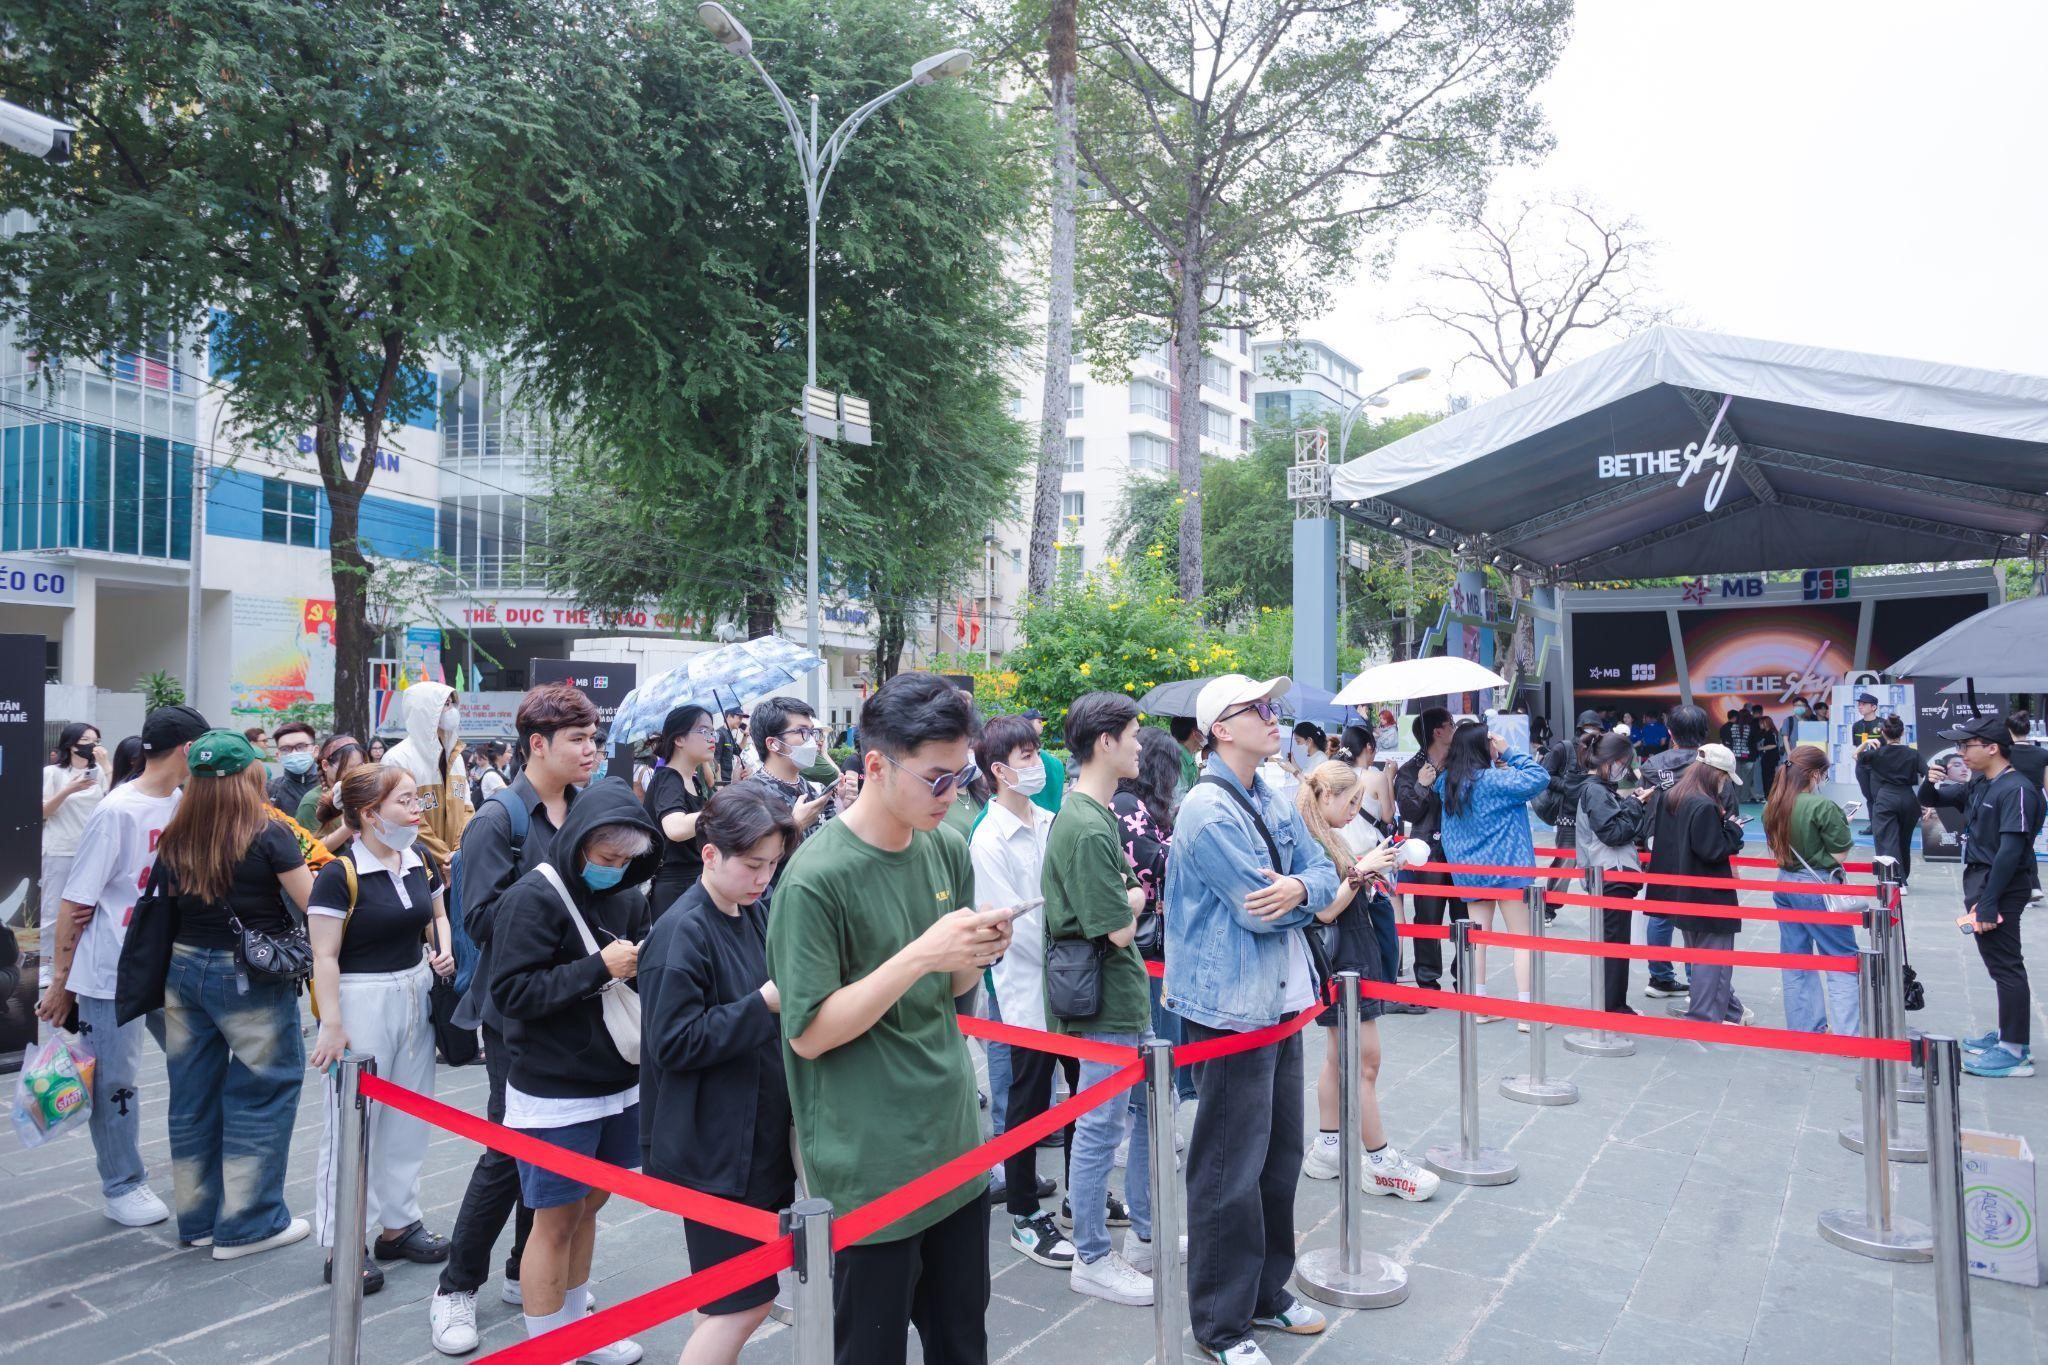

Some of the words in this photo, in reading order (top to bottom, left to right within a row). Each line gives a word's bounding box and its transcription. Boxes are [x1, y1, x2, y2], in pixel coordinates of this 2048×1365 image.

[33, 573, 65, 594] CO
[1722, 578, 1764, 598] MB
[506, 608, 545, 627] DỤC
[575, 678, 588, 687] MB
[1603, 668, 1620, 678] MB
[1374, 1175, 1418, 1195] BOSTON
[1981, 1190, 2000, 1241] AQUAFINA
